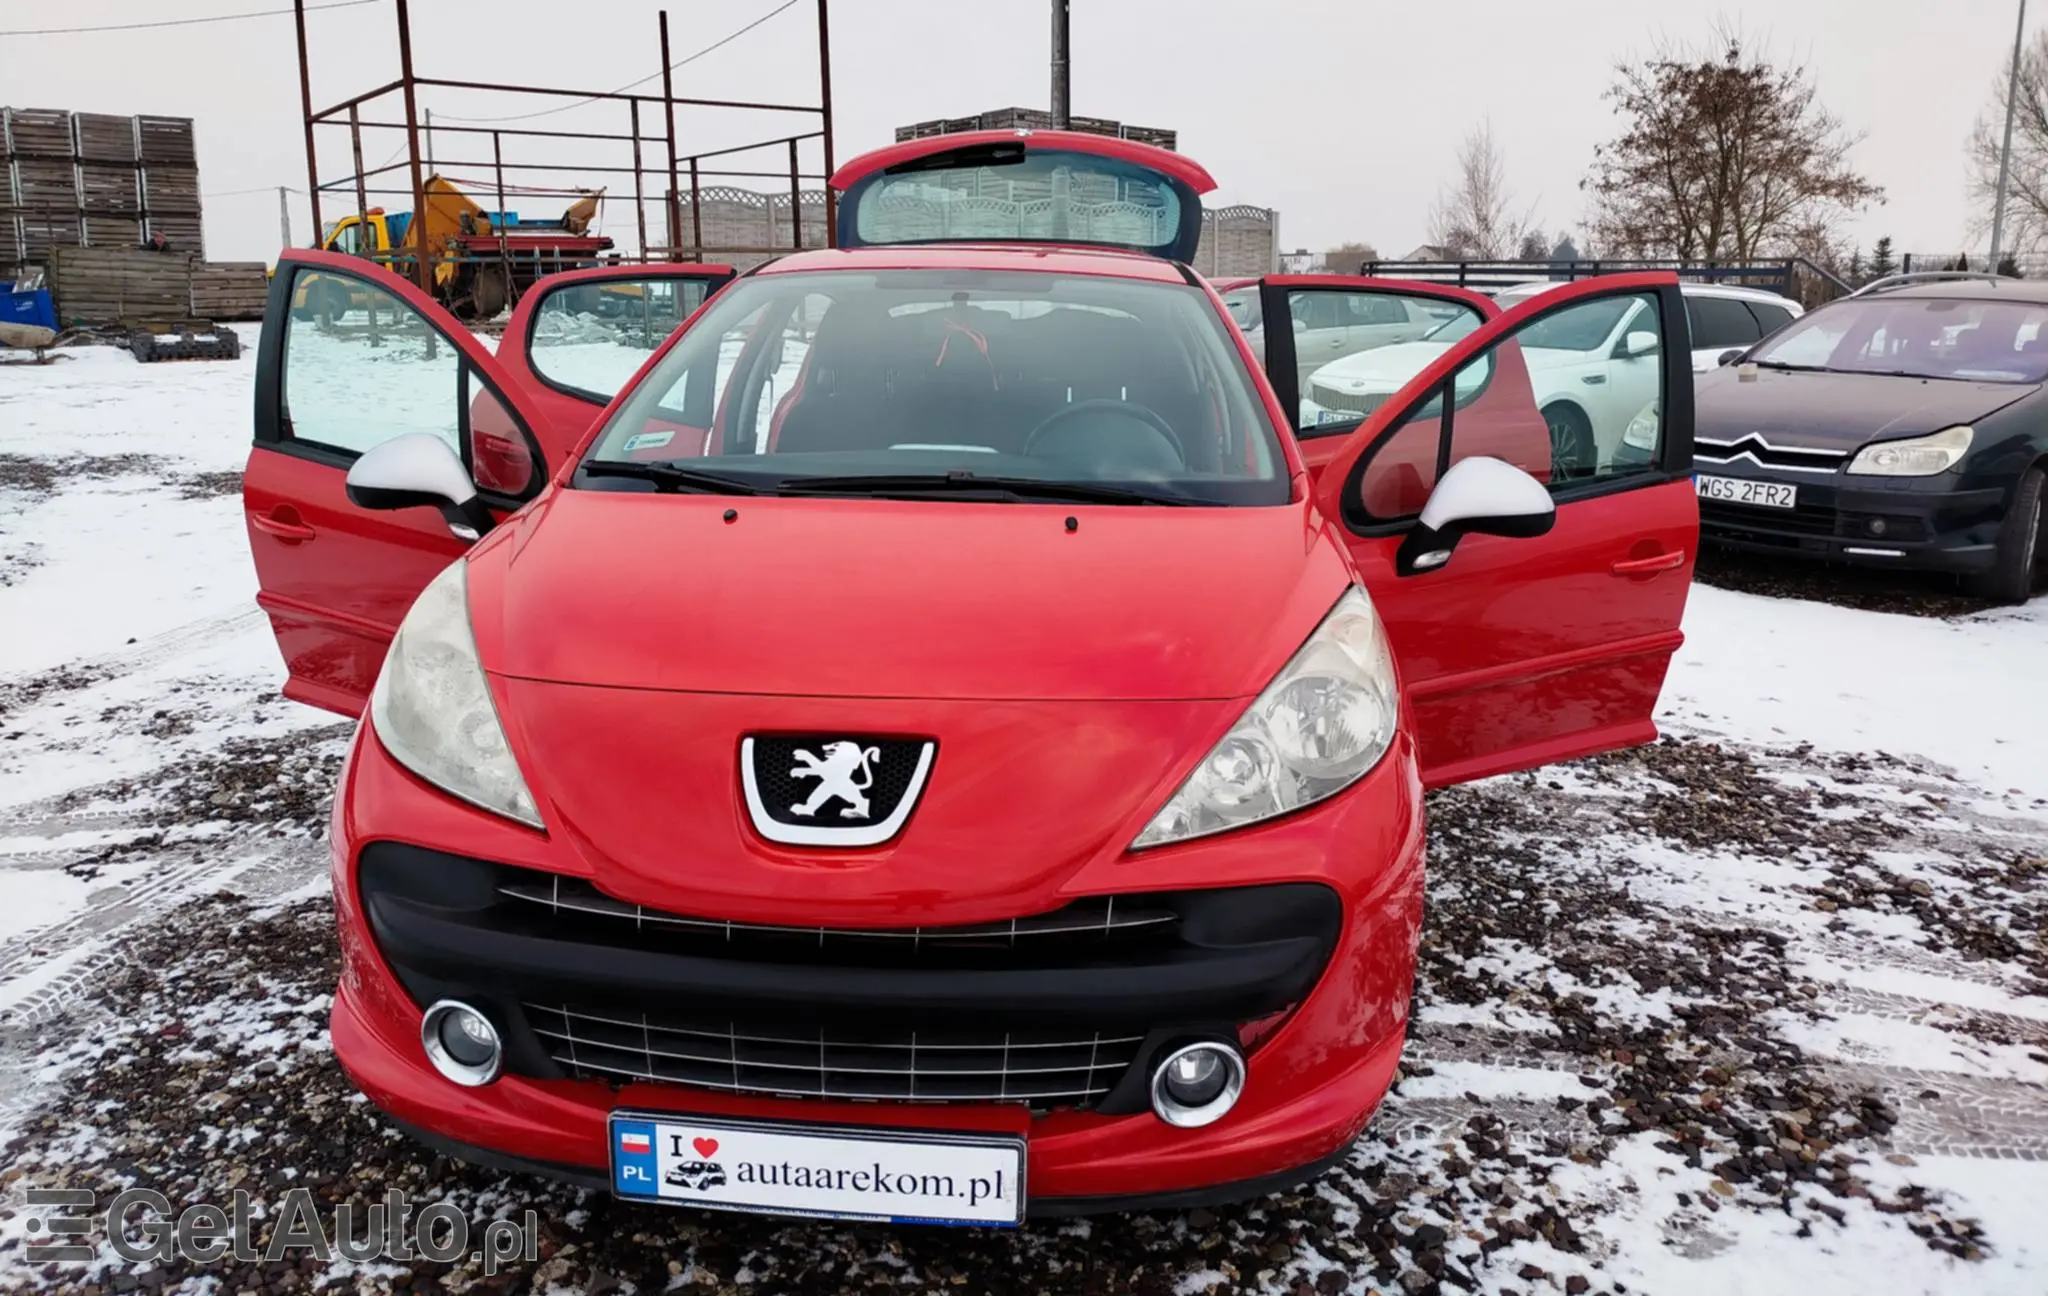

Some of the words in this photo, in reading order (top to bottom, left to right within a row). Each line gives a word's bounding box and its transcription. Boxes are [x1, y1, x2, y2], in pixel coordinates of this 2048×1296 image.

[1700, 477, 1735, 499] WGS
[1741, 482, 1792, 506] 2FR2
[669, 1134, 684, 1158] I
[622, 1164, 652, 1182] PL
[736, 1158, 1004, 1207] autaarekom.pl
